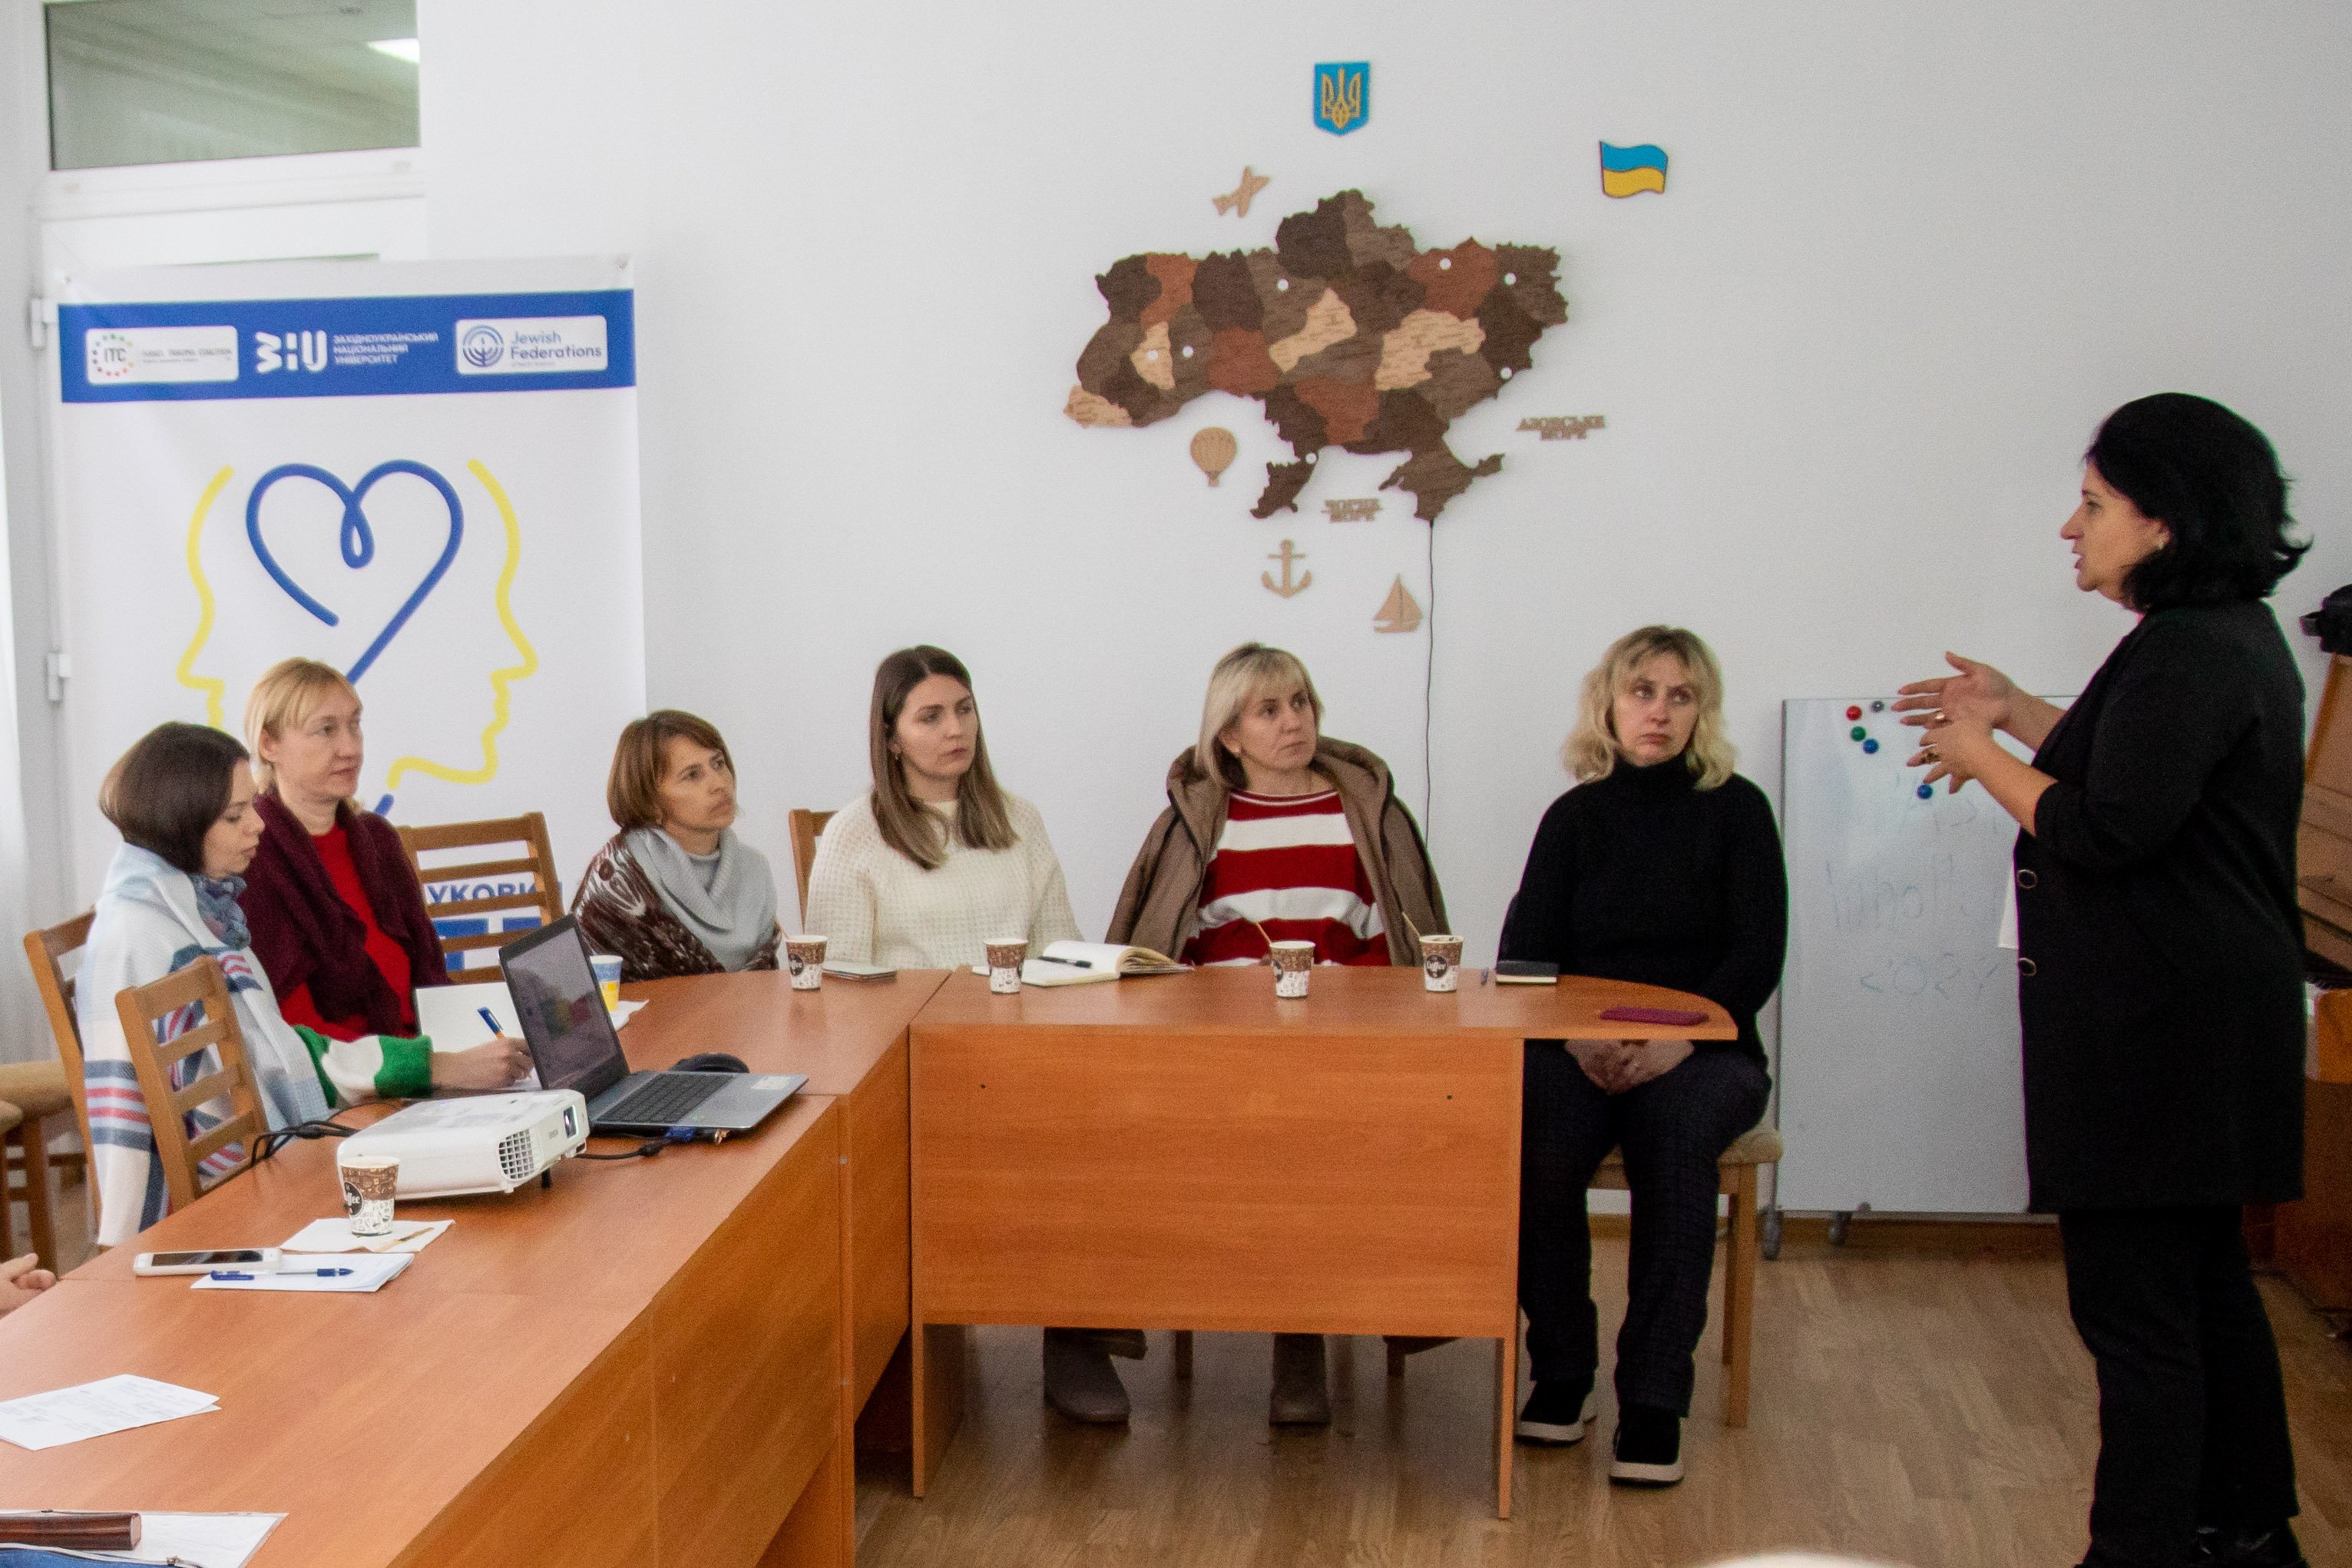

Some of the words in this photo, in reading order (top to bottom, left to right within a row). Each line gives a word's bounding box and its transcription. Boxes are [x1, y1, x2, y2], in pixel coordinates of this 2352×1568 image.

[511, 330, 561, 345] Jewish
[104, 348, 127, 363] ITC
[511, 345, 602, 360] Federations
[427, 881, 563, 906] УКОВИ
